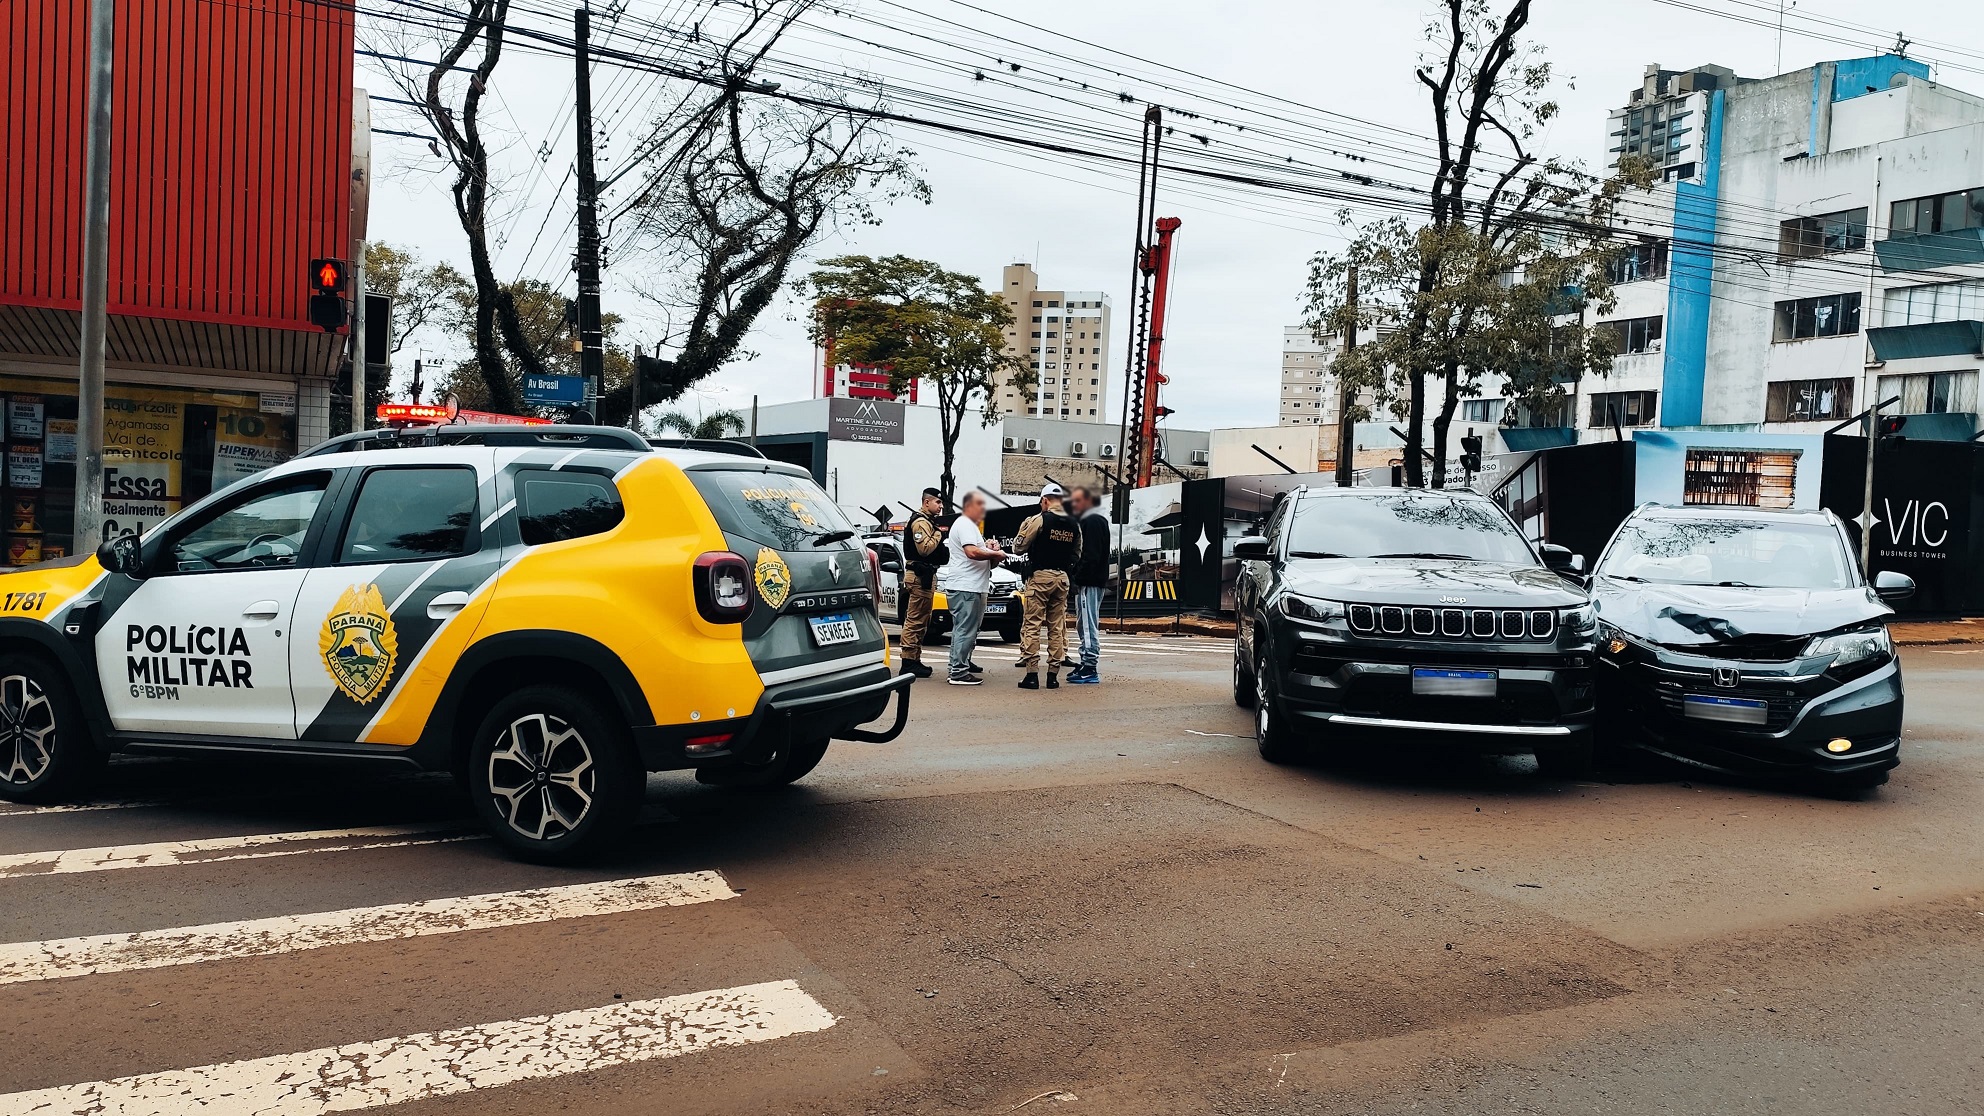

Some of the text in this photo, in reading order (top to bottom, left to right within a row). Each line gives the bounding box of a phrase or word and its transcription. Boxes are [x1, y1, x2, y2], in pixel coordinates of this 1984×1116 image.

[528, 379, 559, 390] Av Brasil
[106, 418, 170, 430] Argamassa
[835, 417, 864, 425] MARTINE
[107, 432, 168, 447] Vai de...
[105, 448, 182, 461] mentcola
[103, 467, 167, 500] Essa
[740, 486, 789, 501] POLÍCIA
[103, 501, 166, 516] Realmente
[1884, 497, 1949, 547] VIC
[1049, 534, 1073, 543] MILITAR
[1050, 528, 1074, 537] POLÍCIA
[1880, 550, 1947, 559] BUSINESS TOWER
[882, 586, 896, 595] LÍCIA
[0, 592, 47, 611] 1781
[807, 594, 866, 607] DUSTER
[1439, 595, 1467, 605] Jeep
[332, 616, 384, 630] PARANÁ
[817, 622, 855, 642] SEW8E65
[126, 623, 252, 656] POLÍCIA
[126, 655, 255, 689] MILITAR
[363, 657, 387, 692] MILITAR
[129, 684, 180, 701] 6ºBPM
